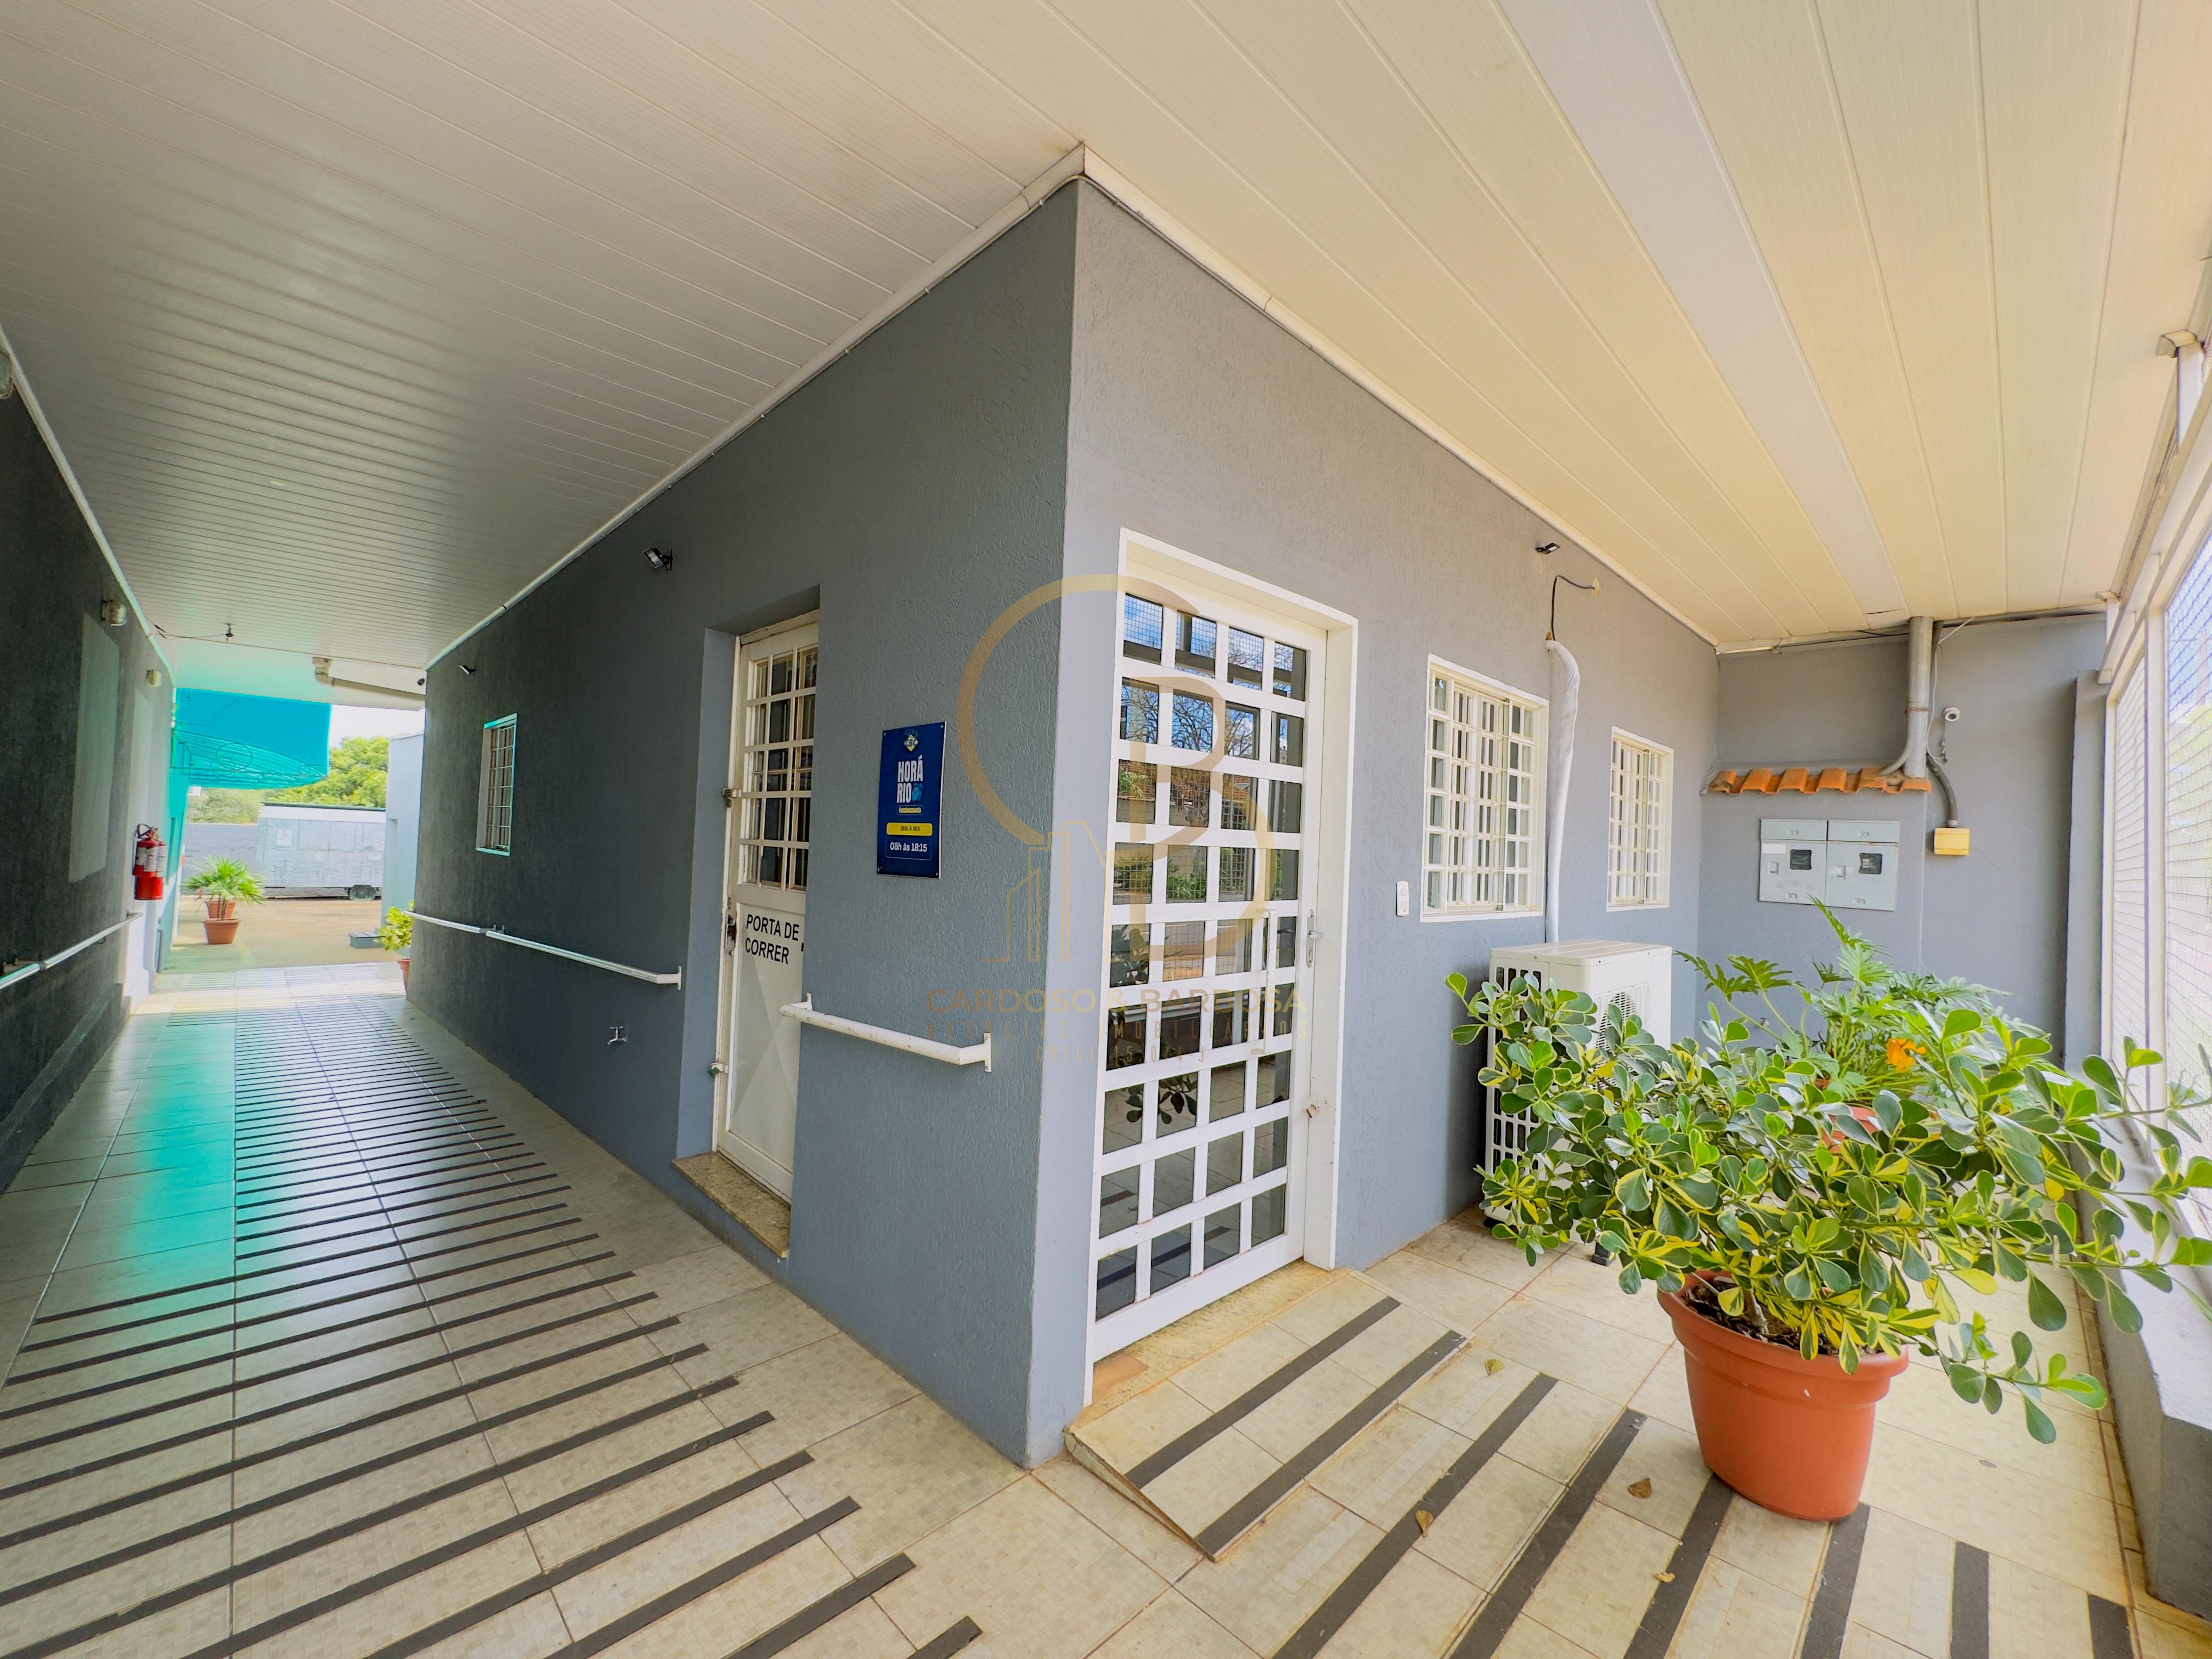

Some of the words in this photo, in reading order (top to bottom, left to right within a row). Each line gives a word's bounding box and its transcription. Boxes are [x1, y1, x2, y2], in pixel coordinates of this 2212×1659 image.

[898, 754, 923, 782] HORÁ
[896, 782, 912, 803] RIO
[890, 842, 902, 850] 08h
[903, 843, 910, 851] às
[746, 914, 781, 937] PORTA
[784, 922, 799, 941] DE
[746, 937, 789, 964] CORRER
